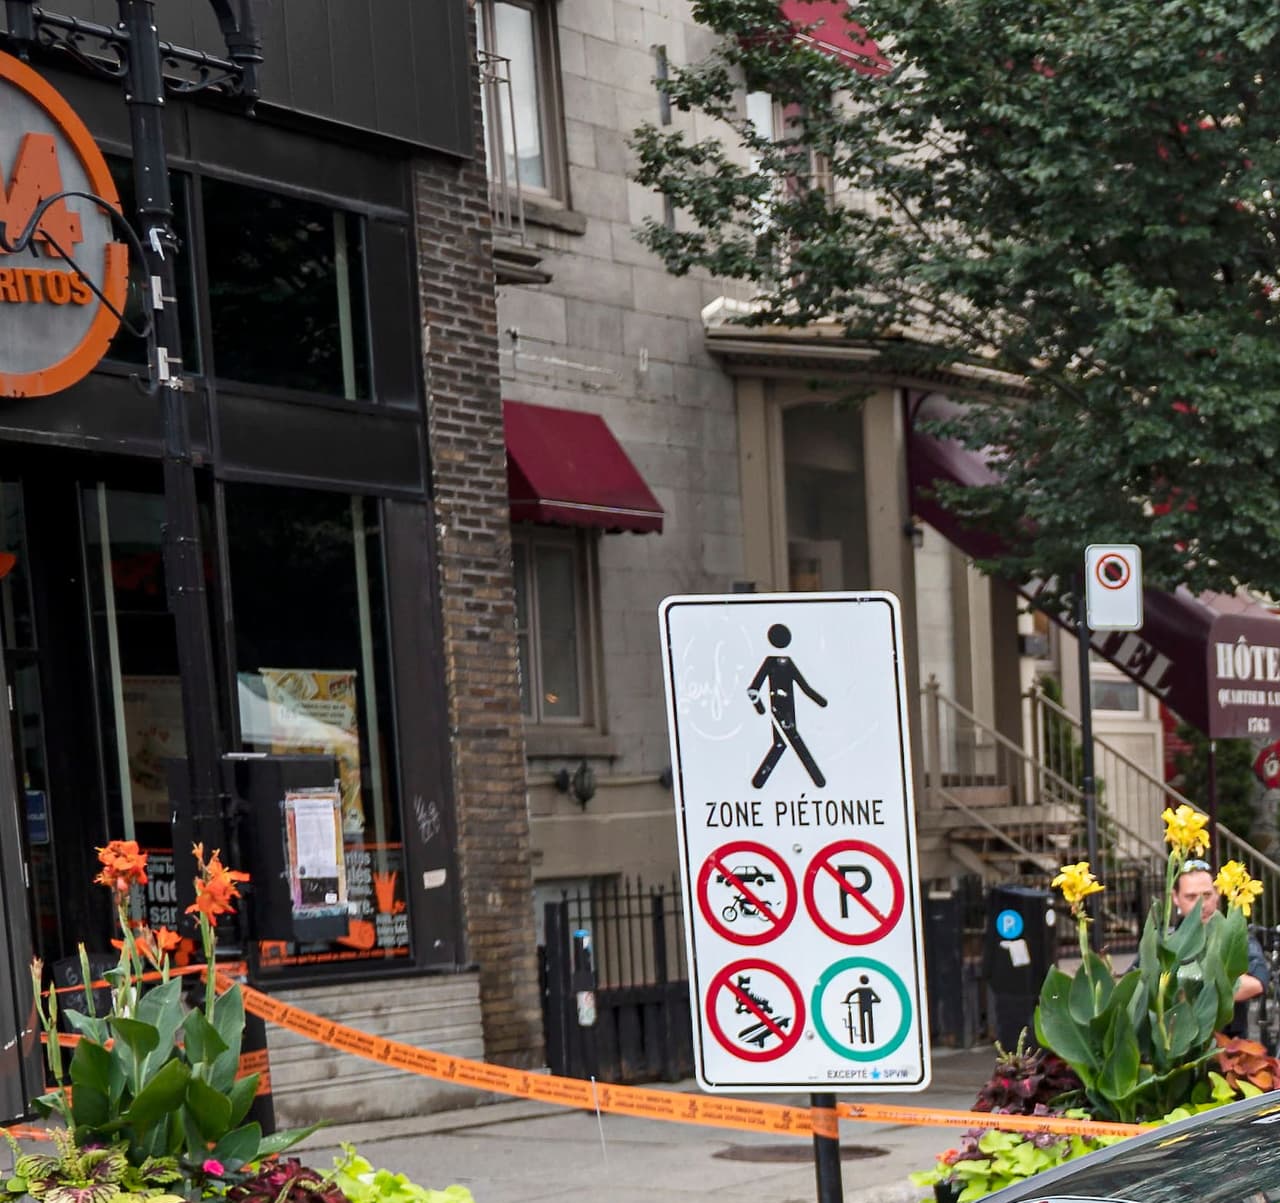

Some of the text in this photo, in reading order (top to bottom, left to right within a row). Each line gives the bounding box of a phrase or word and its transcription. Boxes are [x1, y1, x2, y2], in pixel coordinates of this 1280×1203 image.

[706, 793, 885, 828] ZONE PIÉTONNE
[826, 1066, 868, 1080] EXCEPTÉ
[883, 1069, 909, 1079] SPVM
